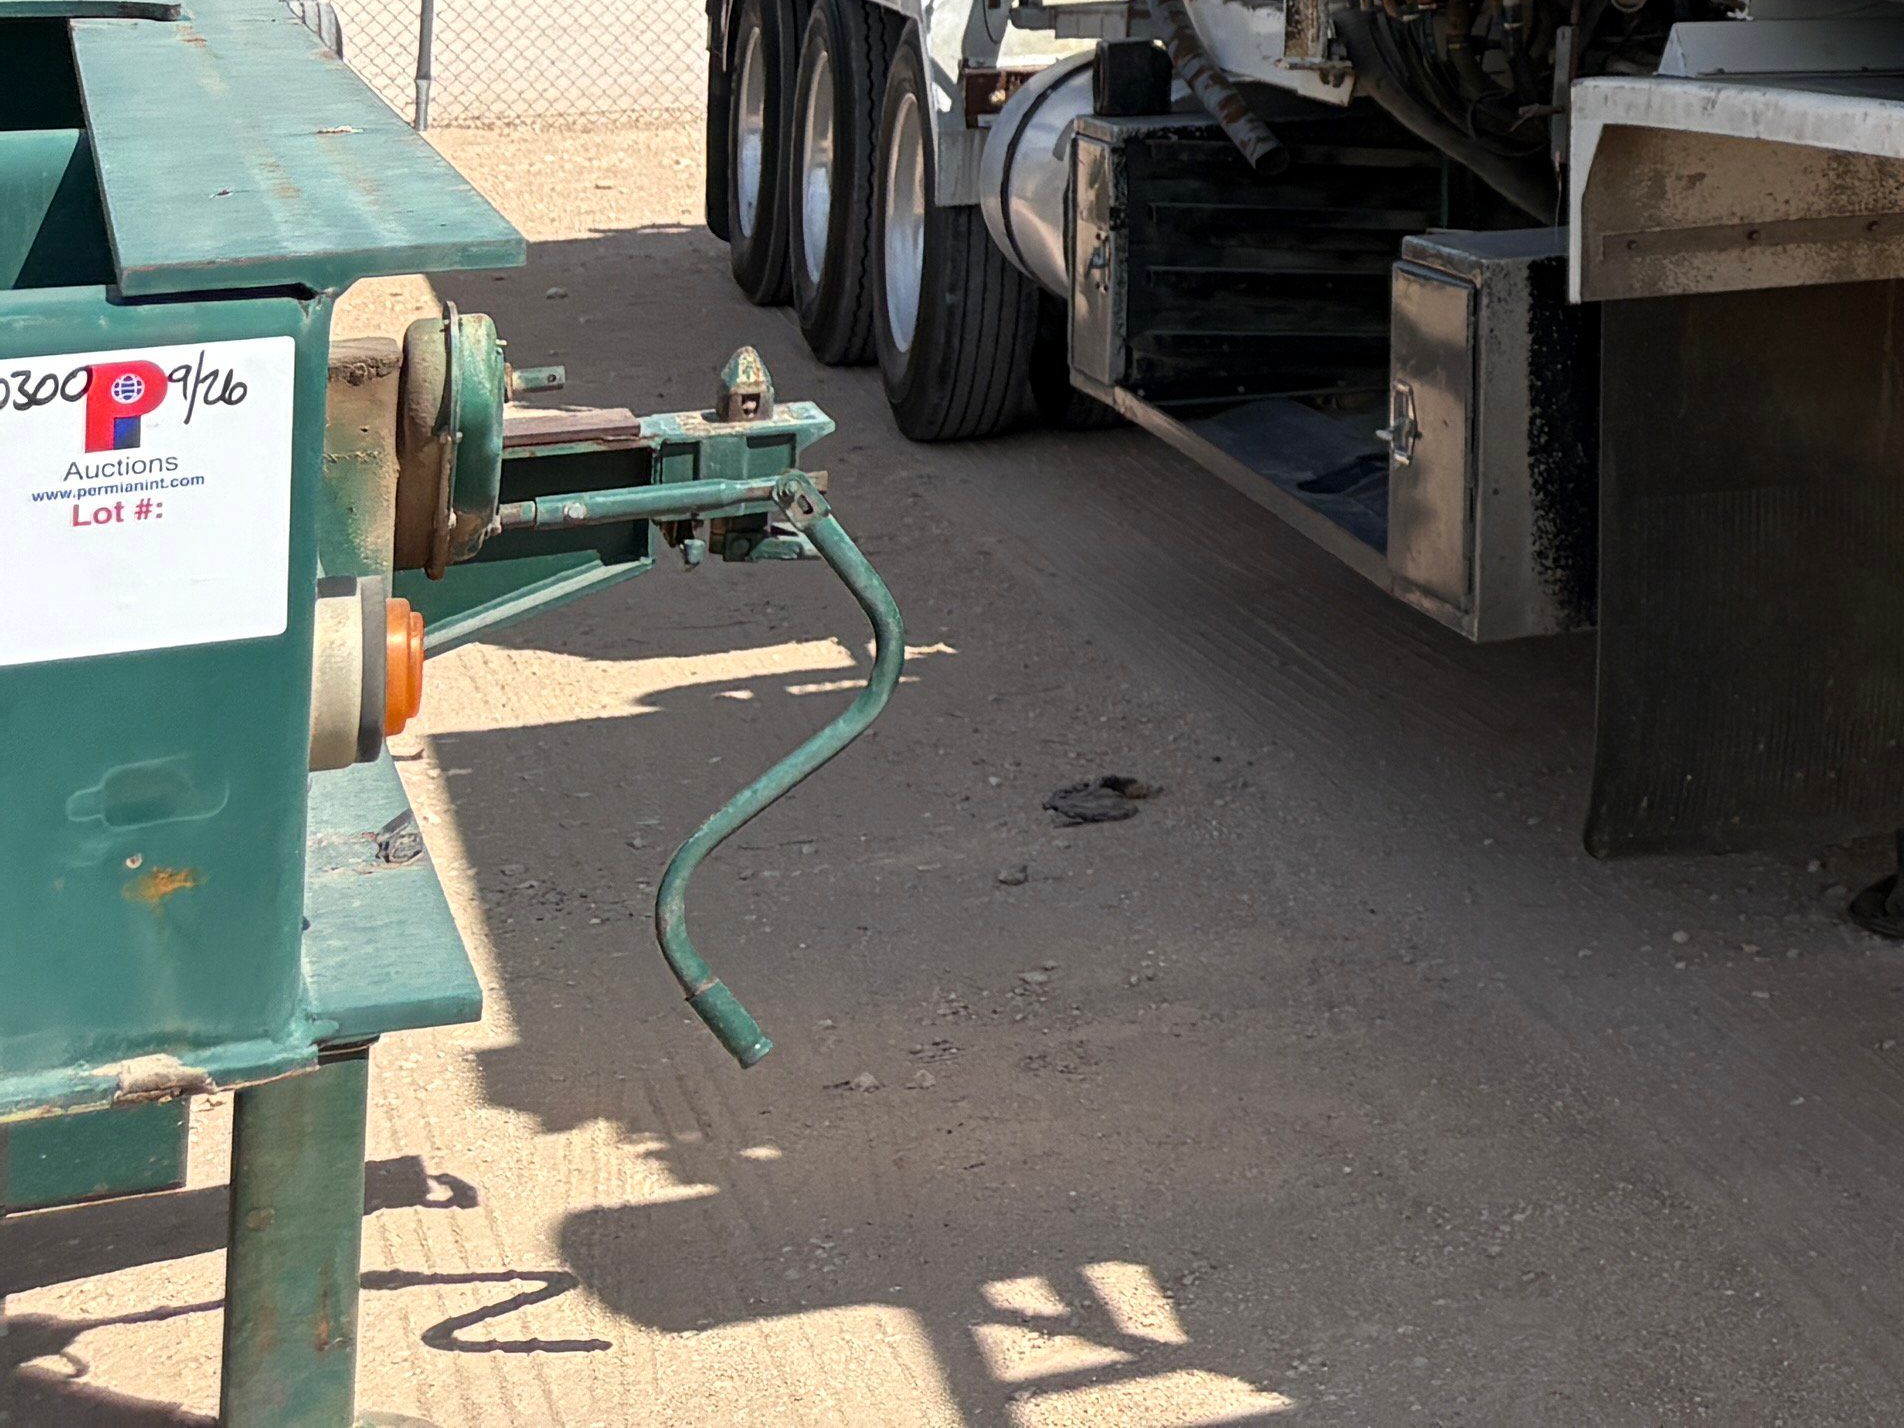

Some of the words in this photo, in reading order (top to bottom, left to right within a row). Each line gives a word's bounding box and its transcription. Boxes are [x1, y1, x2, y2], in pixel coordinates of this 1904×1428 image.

[62, 455, 179, 482] Auctions
[31, 474, 205, 502] www.permianint.com
[72, 501, 125, 527] Lot
[134, 498, 163, 520] #:
